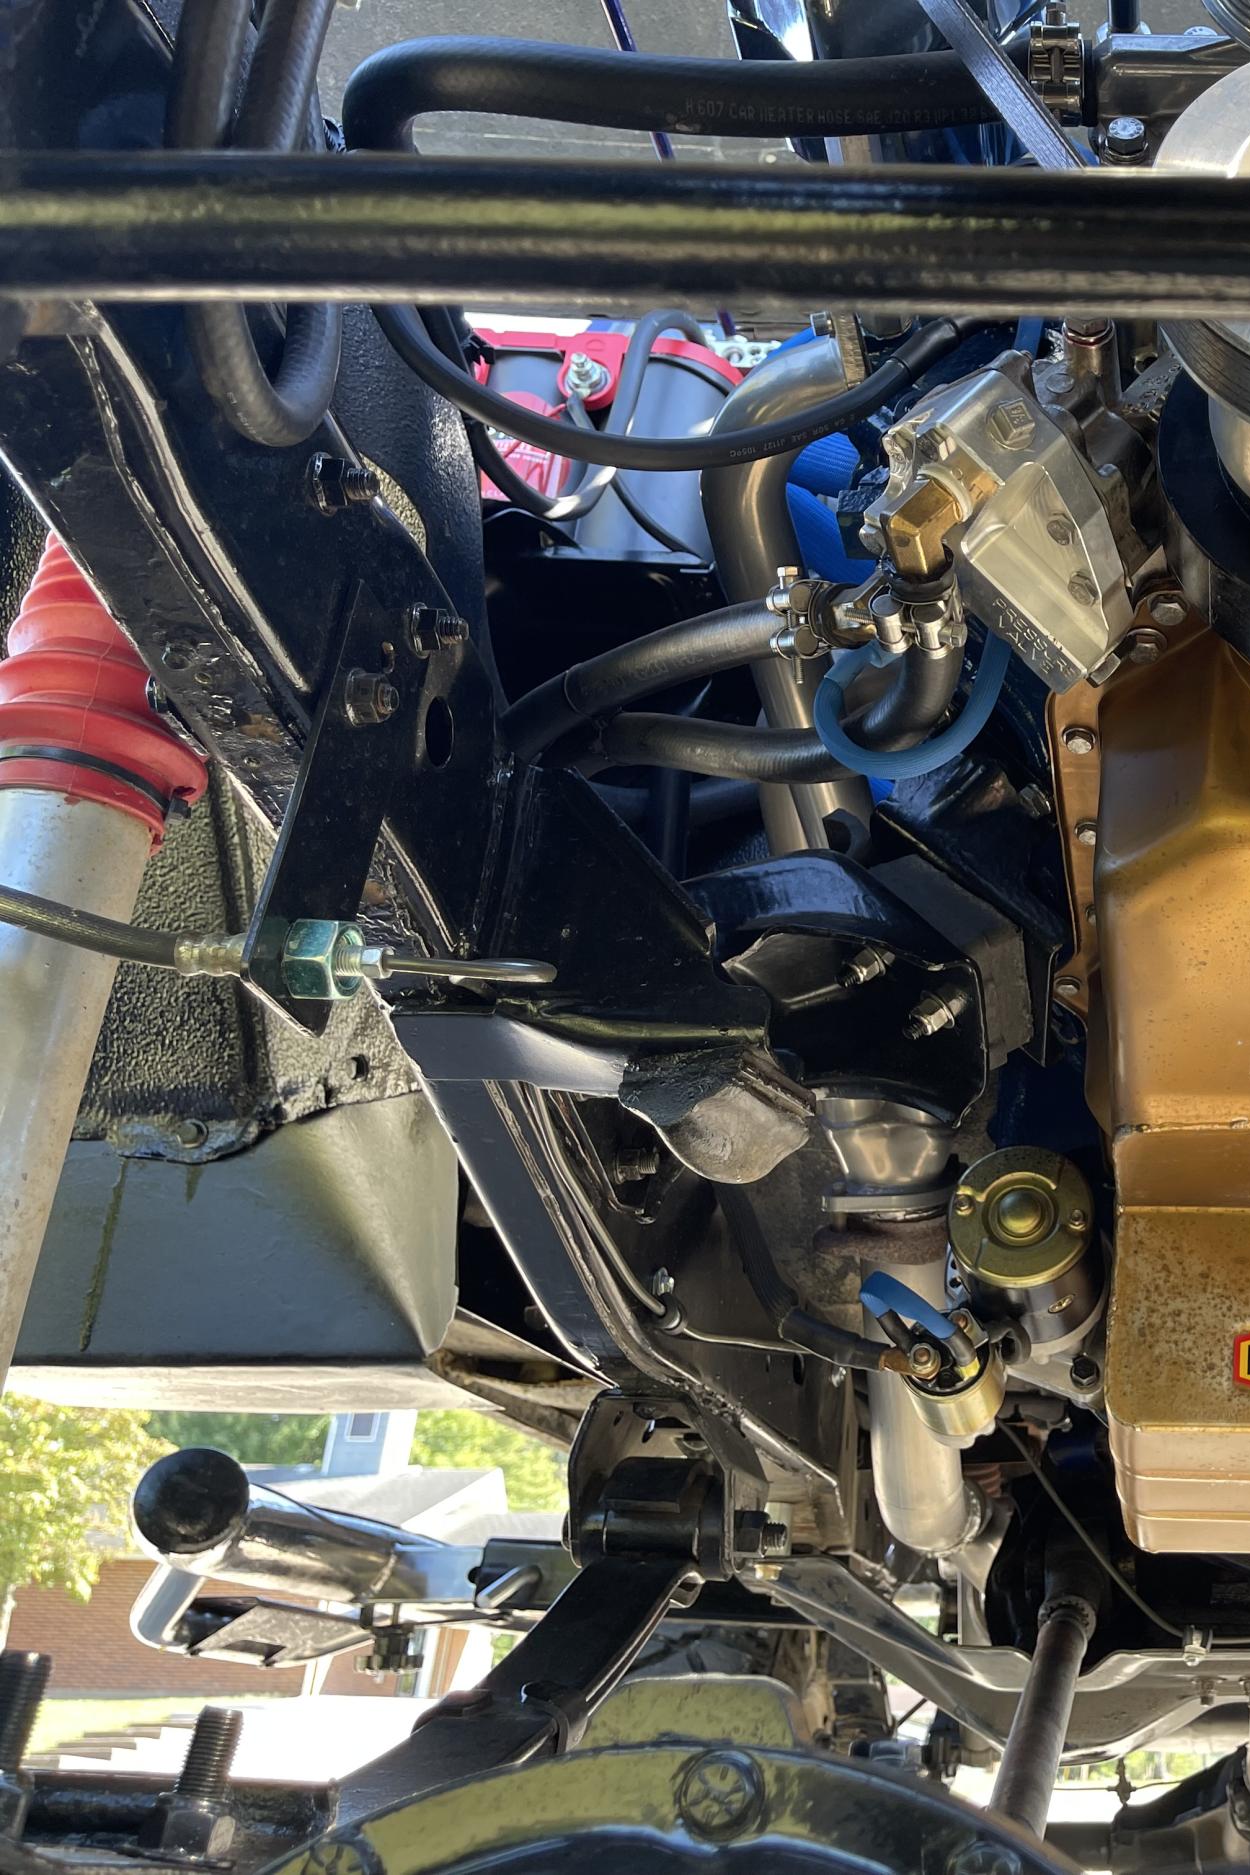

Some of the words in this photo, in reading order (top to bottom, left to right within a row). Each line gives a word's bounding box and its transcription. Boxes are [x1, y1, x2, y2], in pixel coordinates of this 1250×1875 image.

[728, 102, 755, 120] CAR
[759, 105, 814, 124] HEATER
[816, 108, 852, 125] HOSE
[856, 109, 881, 125] SAE
[992, 598, 1076, 678] PRESSURE
[999, 614, 1055, 675] VALVE
